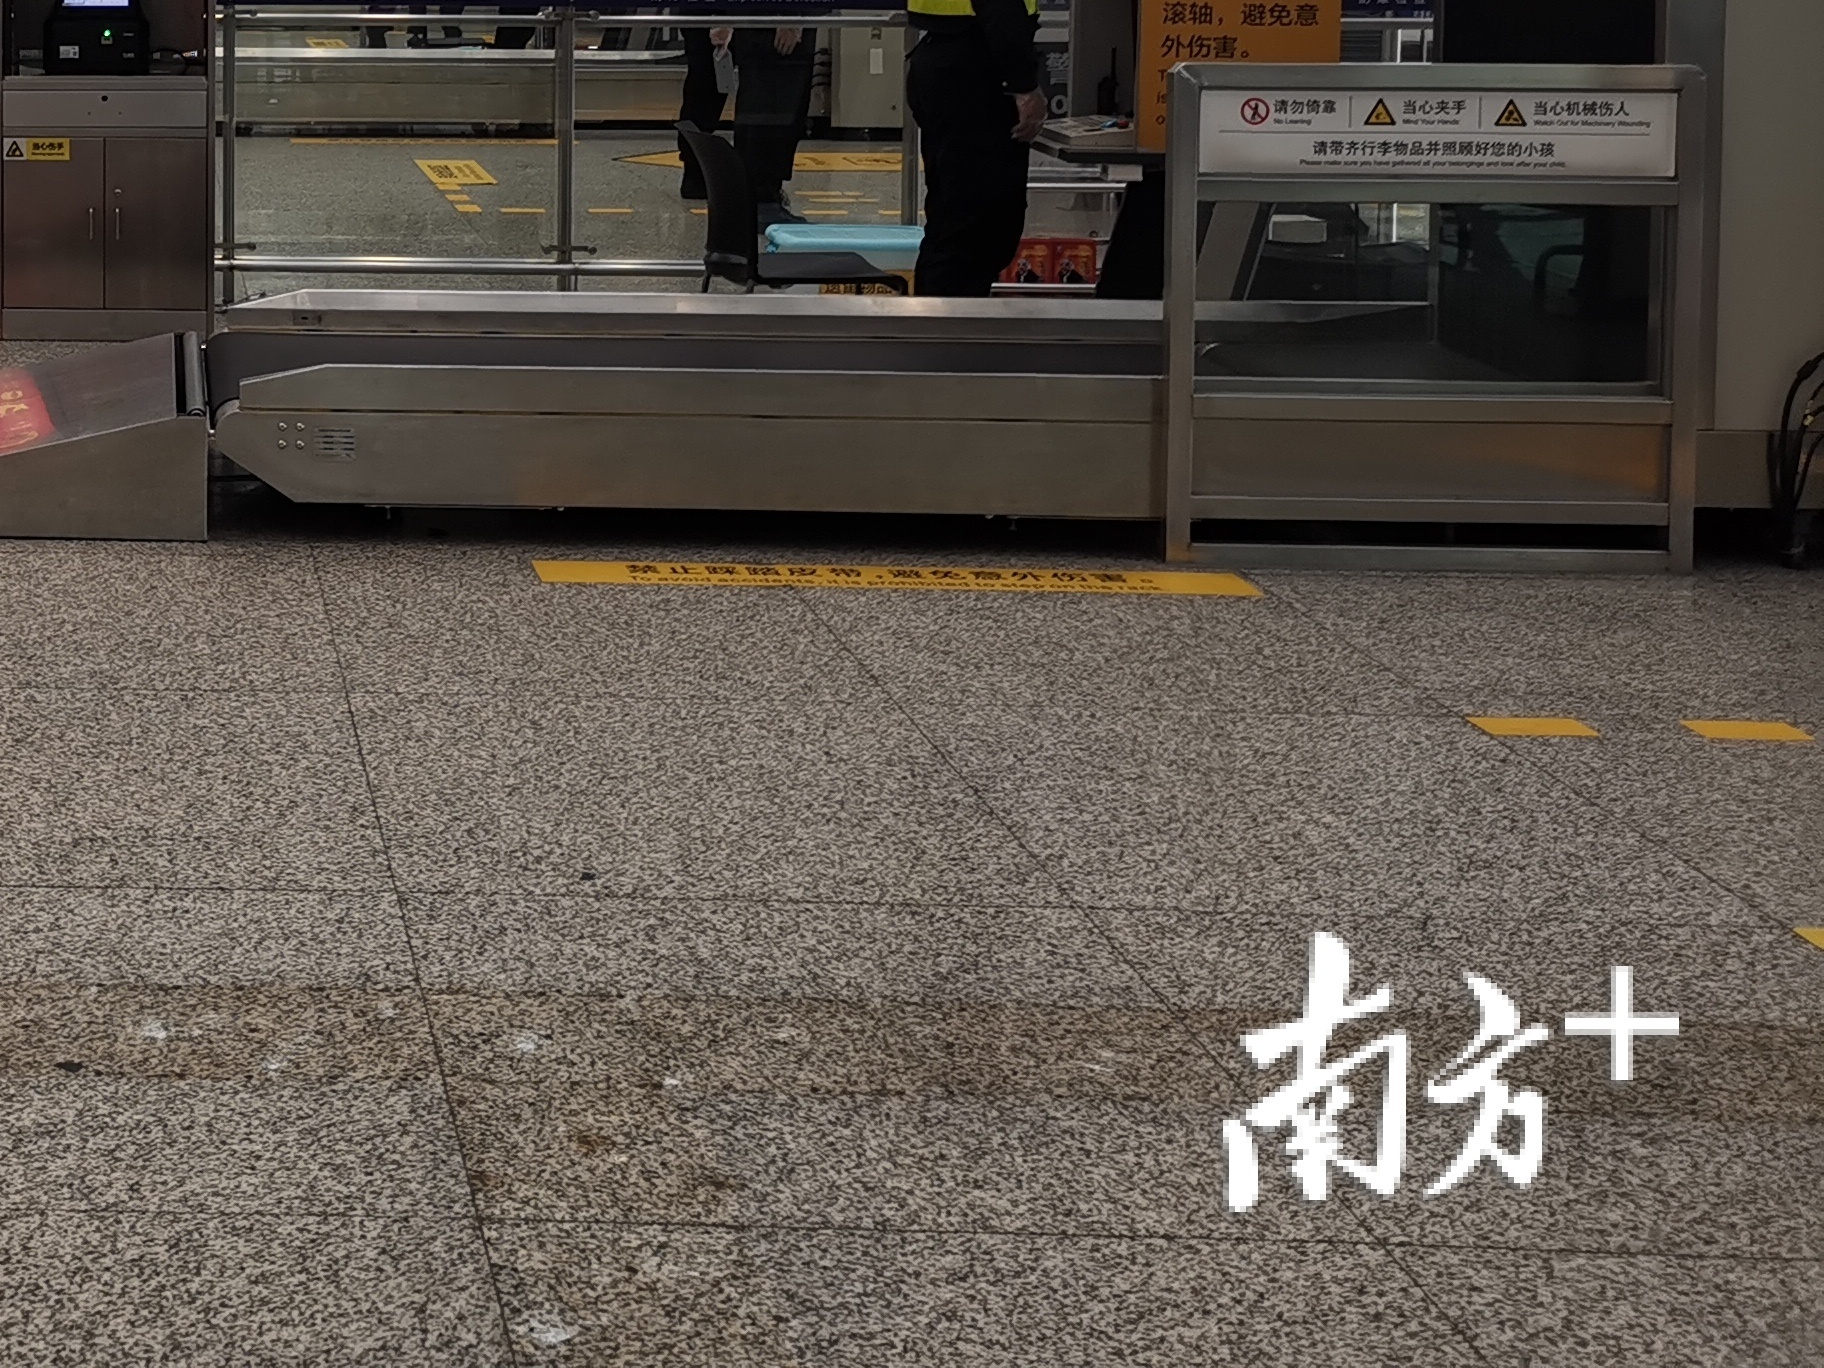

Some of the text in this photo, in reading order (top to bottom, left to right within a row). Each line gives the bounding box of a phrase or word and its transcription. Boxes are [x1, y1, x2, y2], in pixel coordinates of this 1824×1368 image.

[1162, 1, 1320, 28] 滚轴，避免意
[1273, 98, 1337, 114] 请勿倚靠
[1402, 99, 1467, 115] 当心夹手
[1533, 100, 1630, 117] 当心机械伤人
[1312, 140, 1555, 158] 请带齐行李物品并照顾好您的小孩
